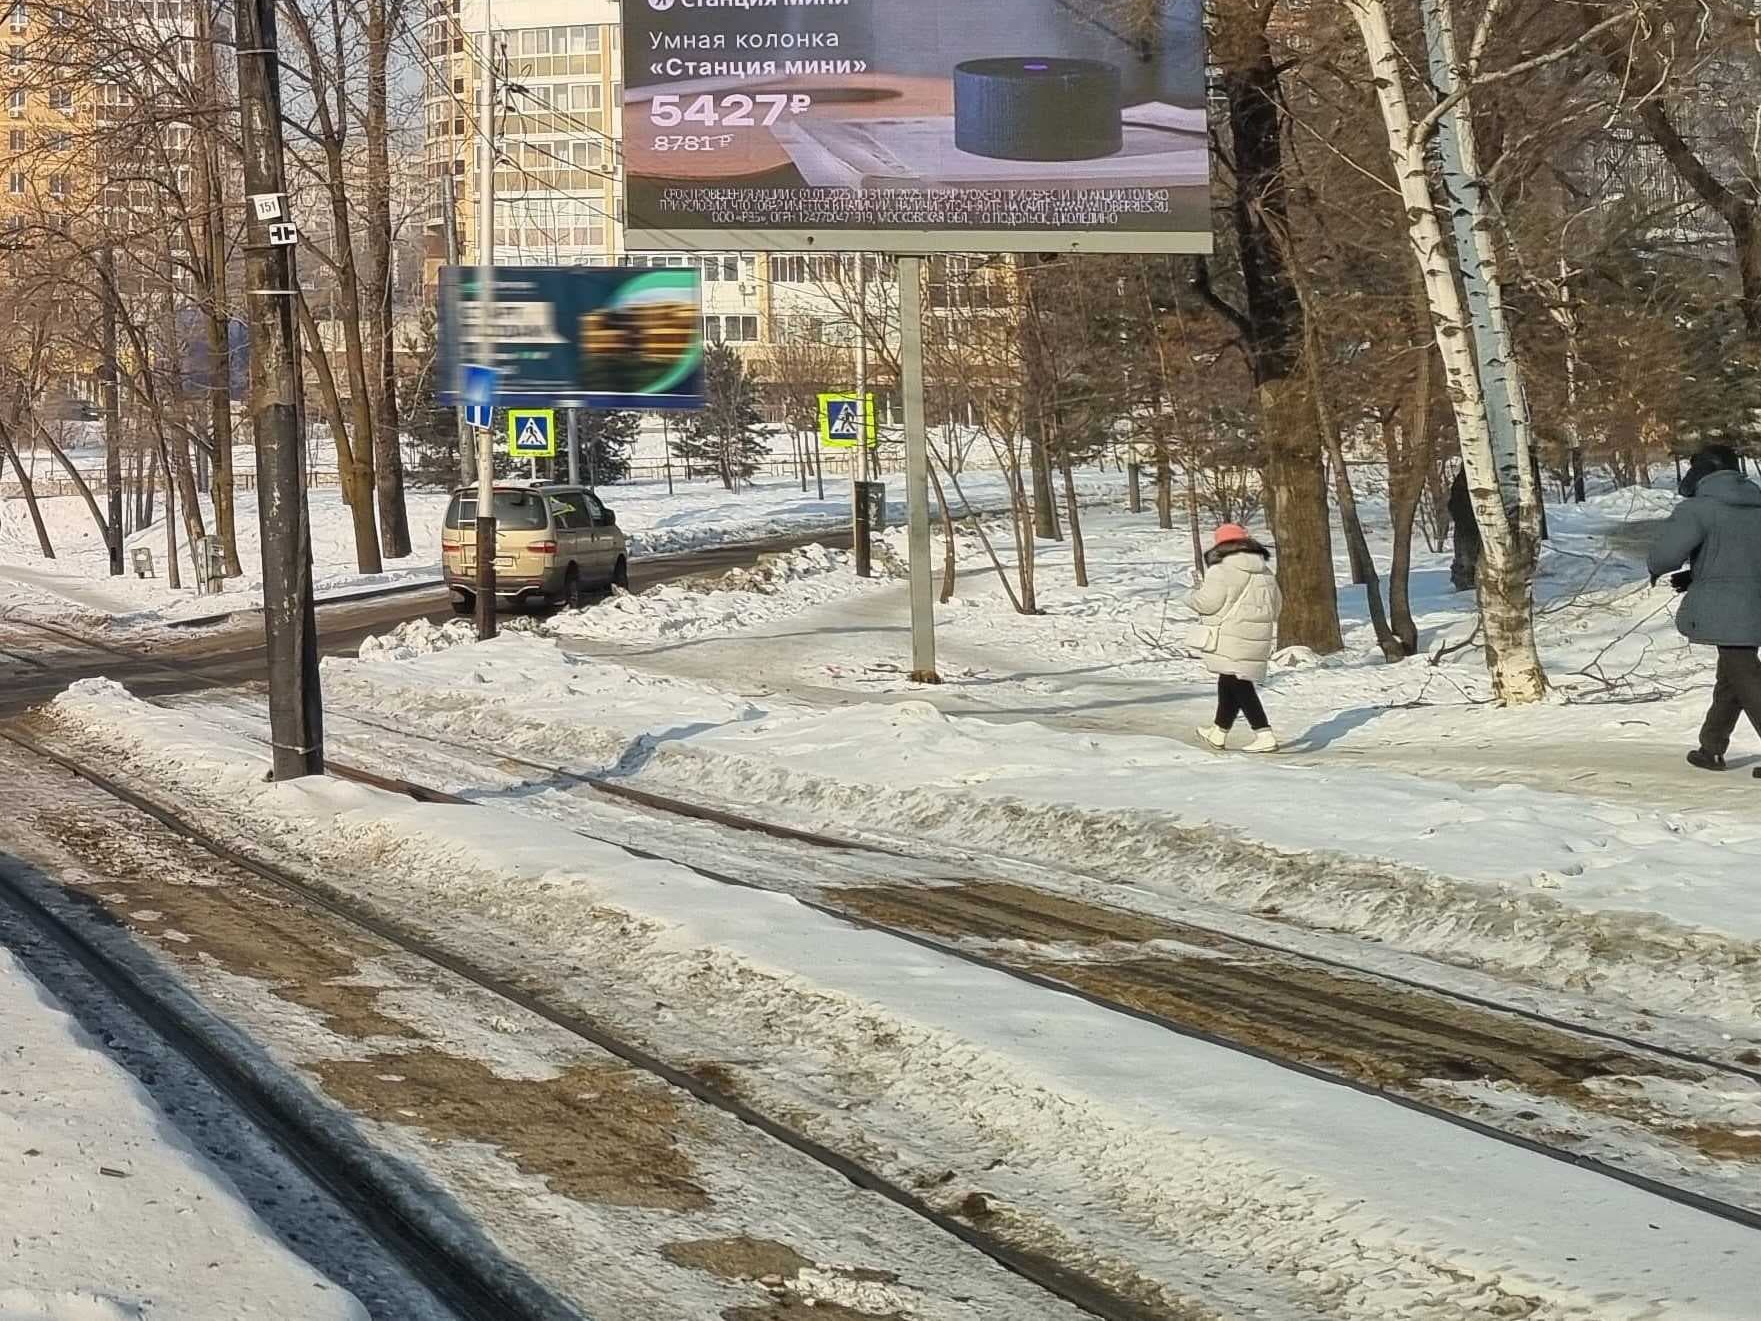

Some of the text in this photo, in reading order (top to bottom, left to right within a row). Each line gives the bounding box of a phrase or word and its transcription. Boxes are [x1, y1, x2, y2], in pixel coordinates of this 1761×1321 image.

[649, 31, 840, 49] Умная колонка
[650, 58, 867, 78] «Станция мини»
[258, 200, 277, 214] 151
